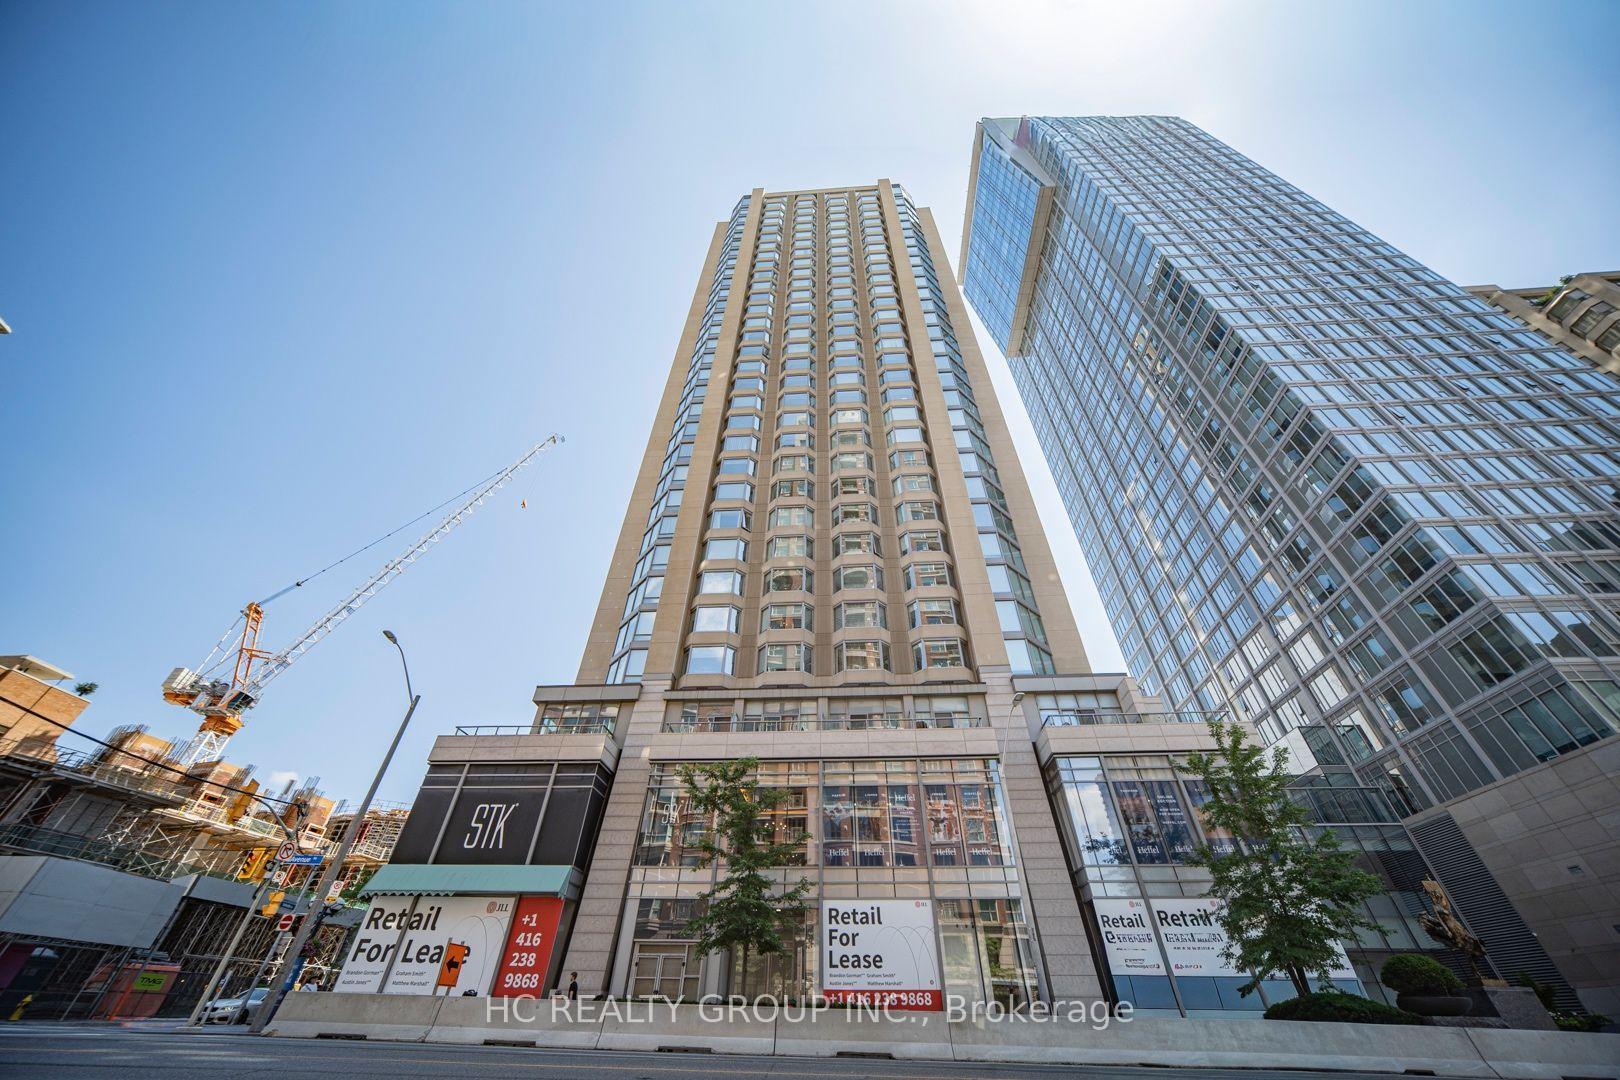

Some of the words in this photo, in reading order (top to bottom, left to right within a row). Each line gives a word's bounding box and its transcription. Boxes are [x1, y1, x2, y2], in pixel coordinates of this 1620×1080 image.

[464, 803, 517, 849] STK
[830, 848, 849, 856] Heffel
[864, 848, 884, 856] Heffel
[936, 848, 956, 856] Heffel
[972, 848, 992, 856] Heffel
[1137, 845, 1160, 854] Heffel
[496, 904, 508, 912] JLL
[365, 906, 442, 930] Retail
[522, 913, 538, 926] +1
[828, 906, 882, 925] Retail
[1100, 914, 1146, 928] Retail
[516, 932, 542, 946] 416
[828, 928, 860, 946] For
[352, 938, 396, 962] For
[509, 952, 536, 967] 238
[828, 950, 883, 968] Lease
[504, 973, 539, 988] 9868
[901, 992, 932, 1006] 9868
